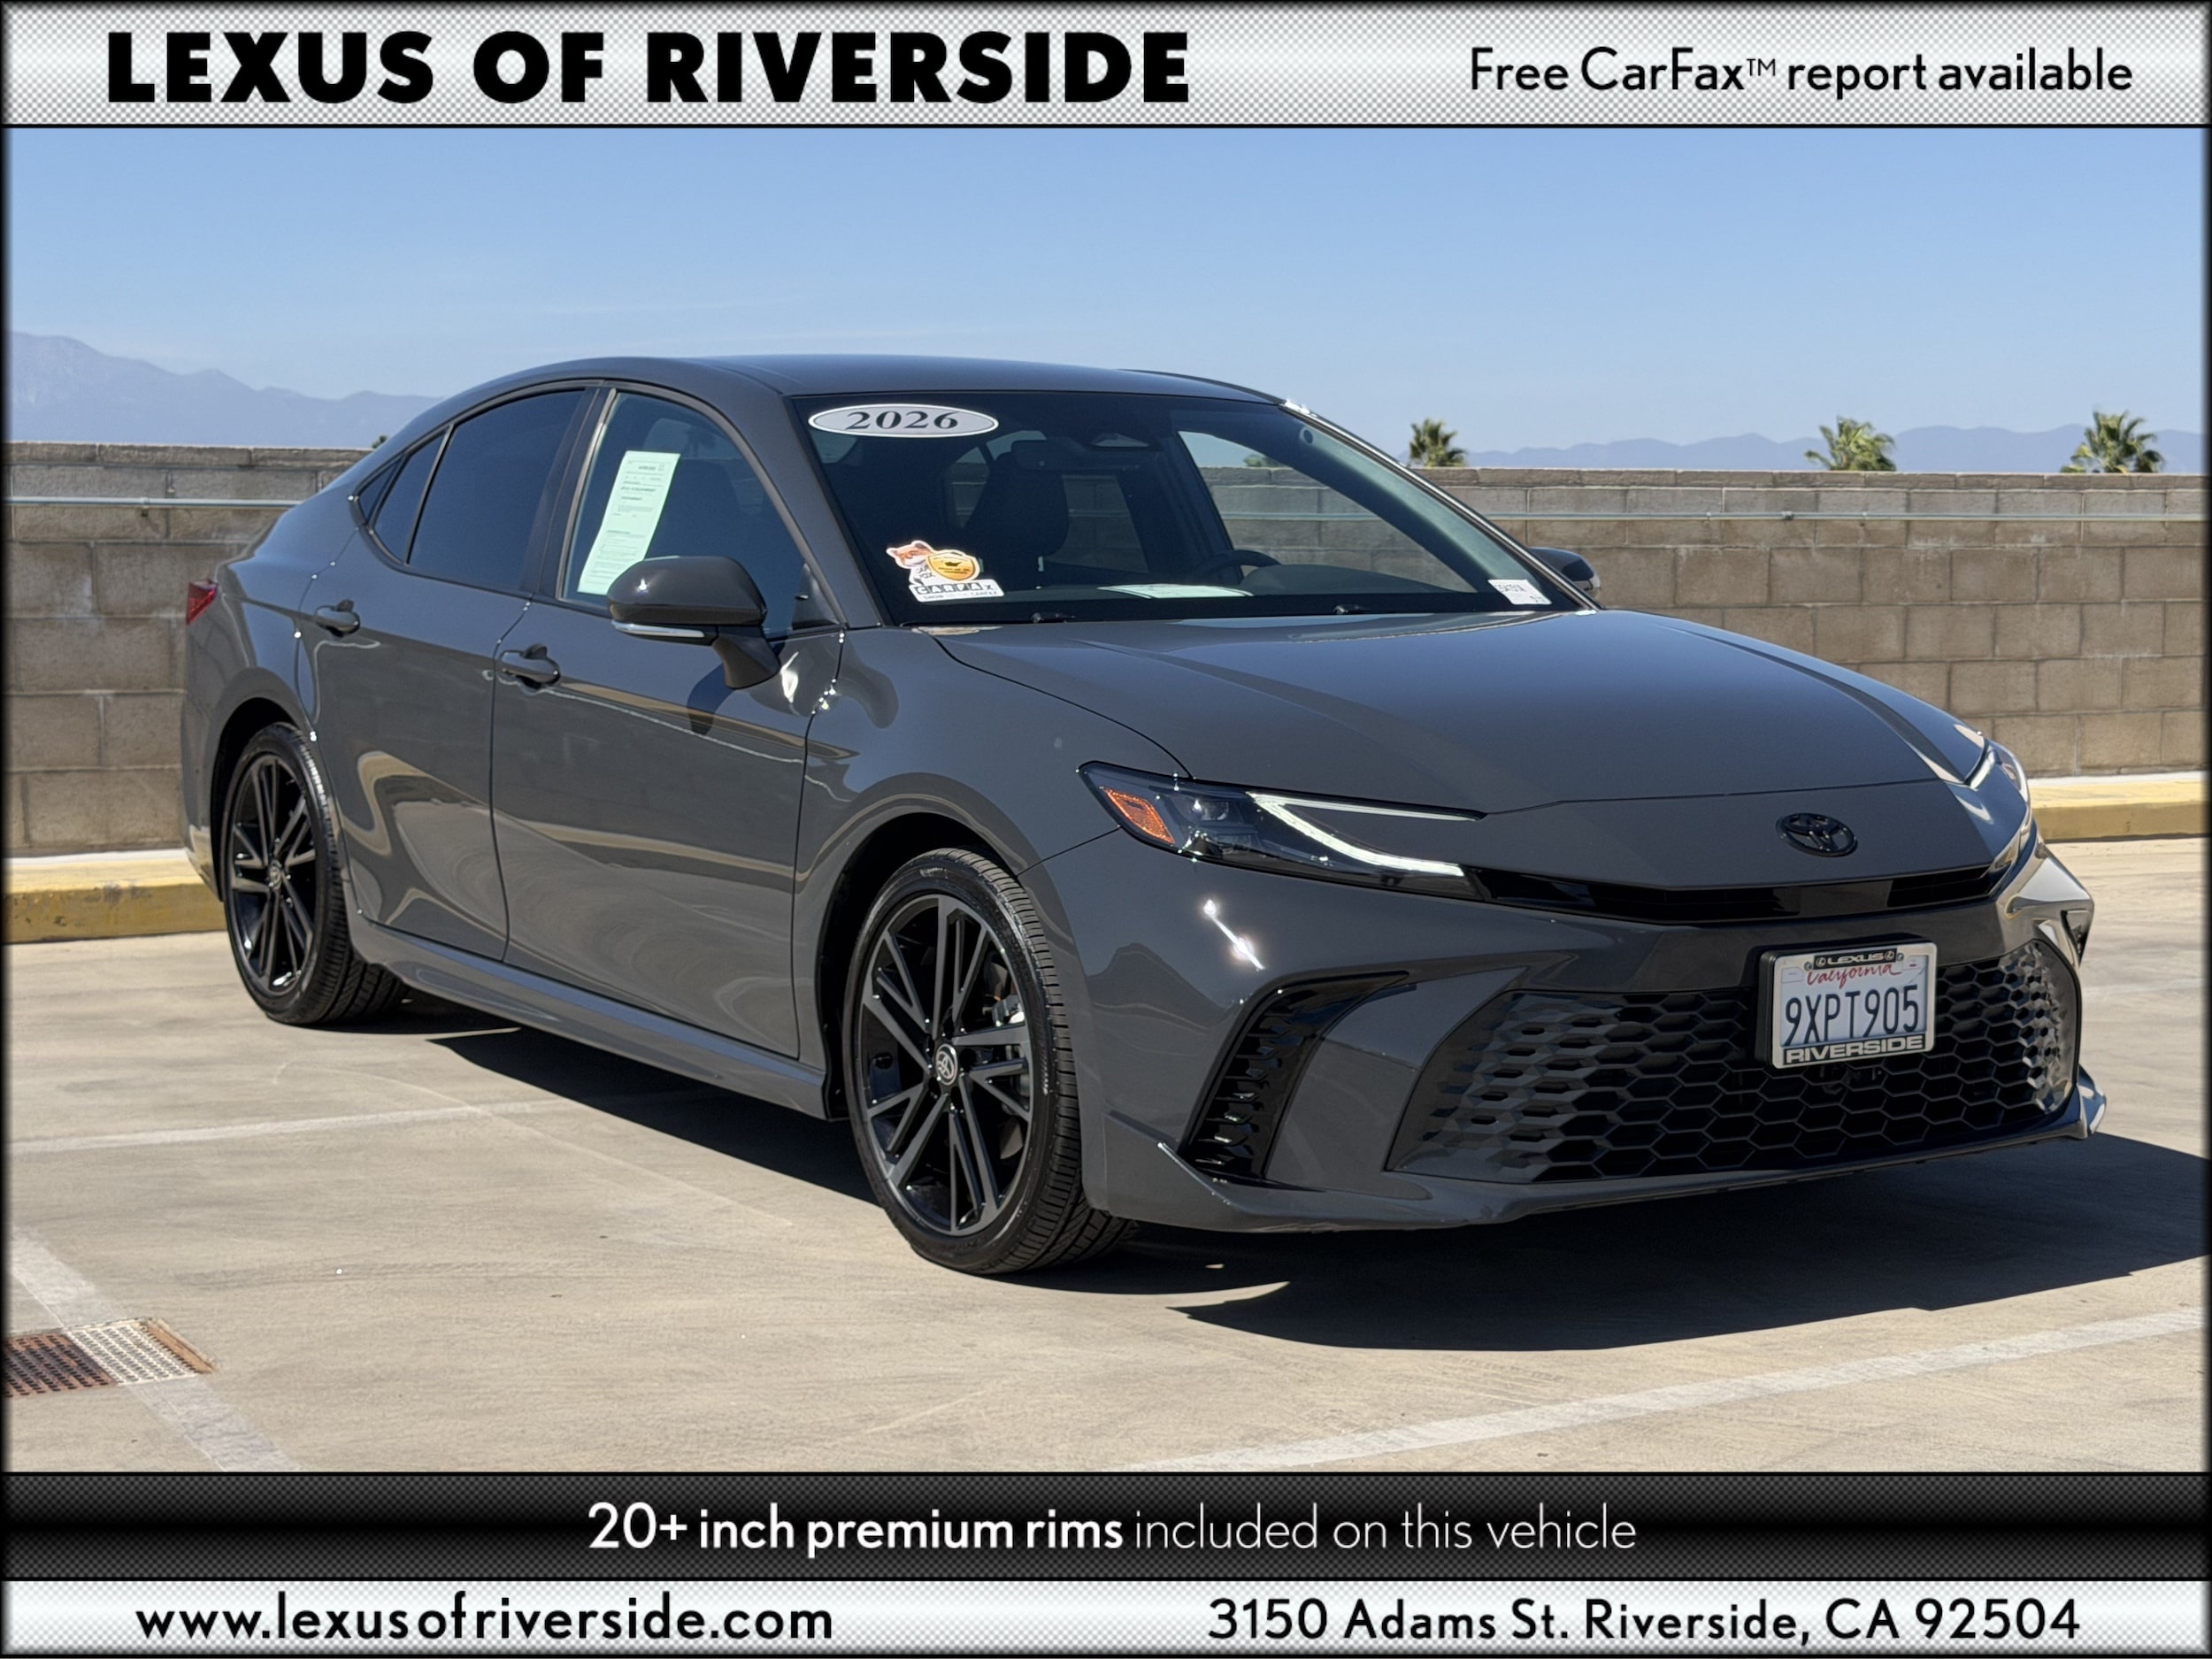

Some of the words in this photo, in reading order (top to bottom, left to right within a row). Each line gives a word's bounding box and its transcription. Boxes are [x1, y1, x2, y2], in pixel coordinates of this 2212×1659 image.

[845, 411, 961, 430] 2026
[915, 582, 994, 595] CARFAX
[1827, 953, 1884, 965] LEXUS
[1785, 984, 1919, 1048] 9XPT905
[1786, 1035, 1924, 1064] RIVERSIDE
